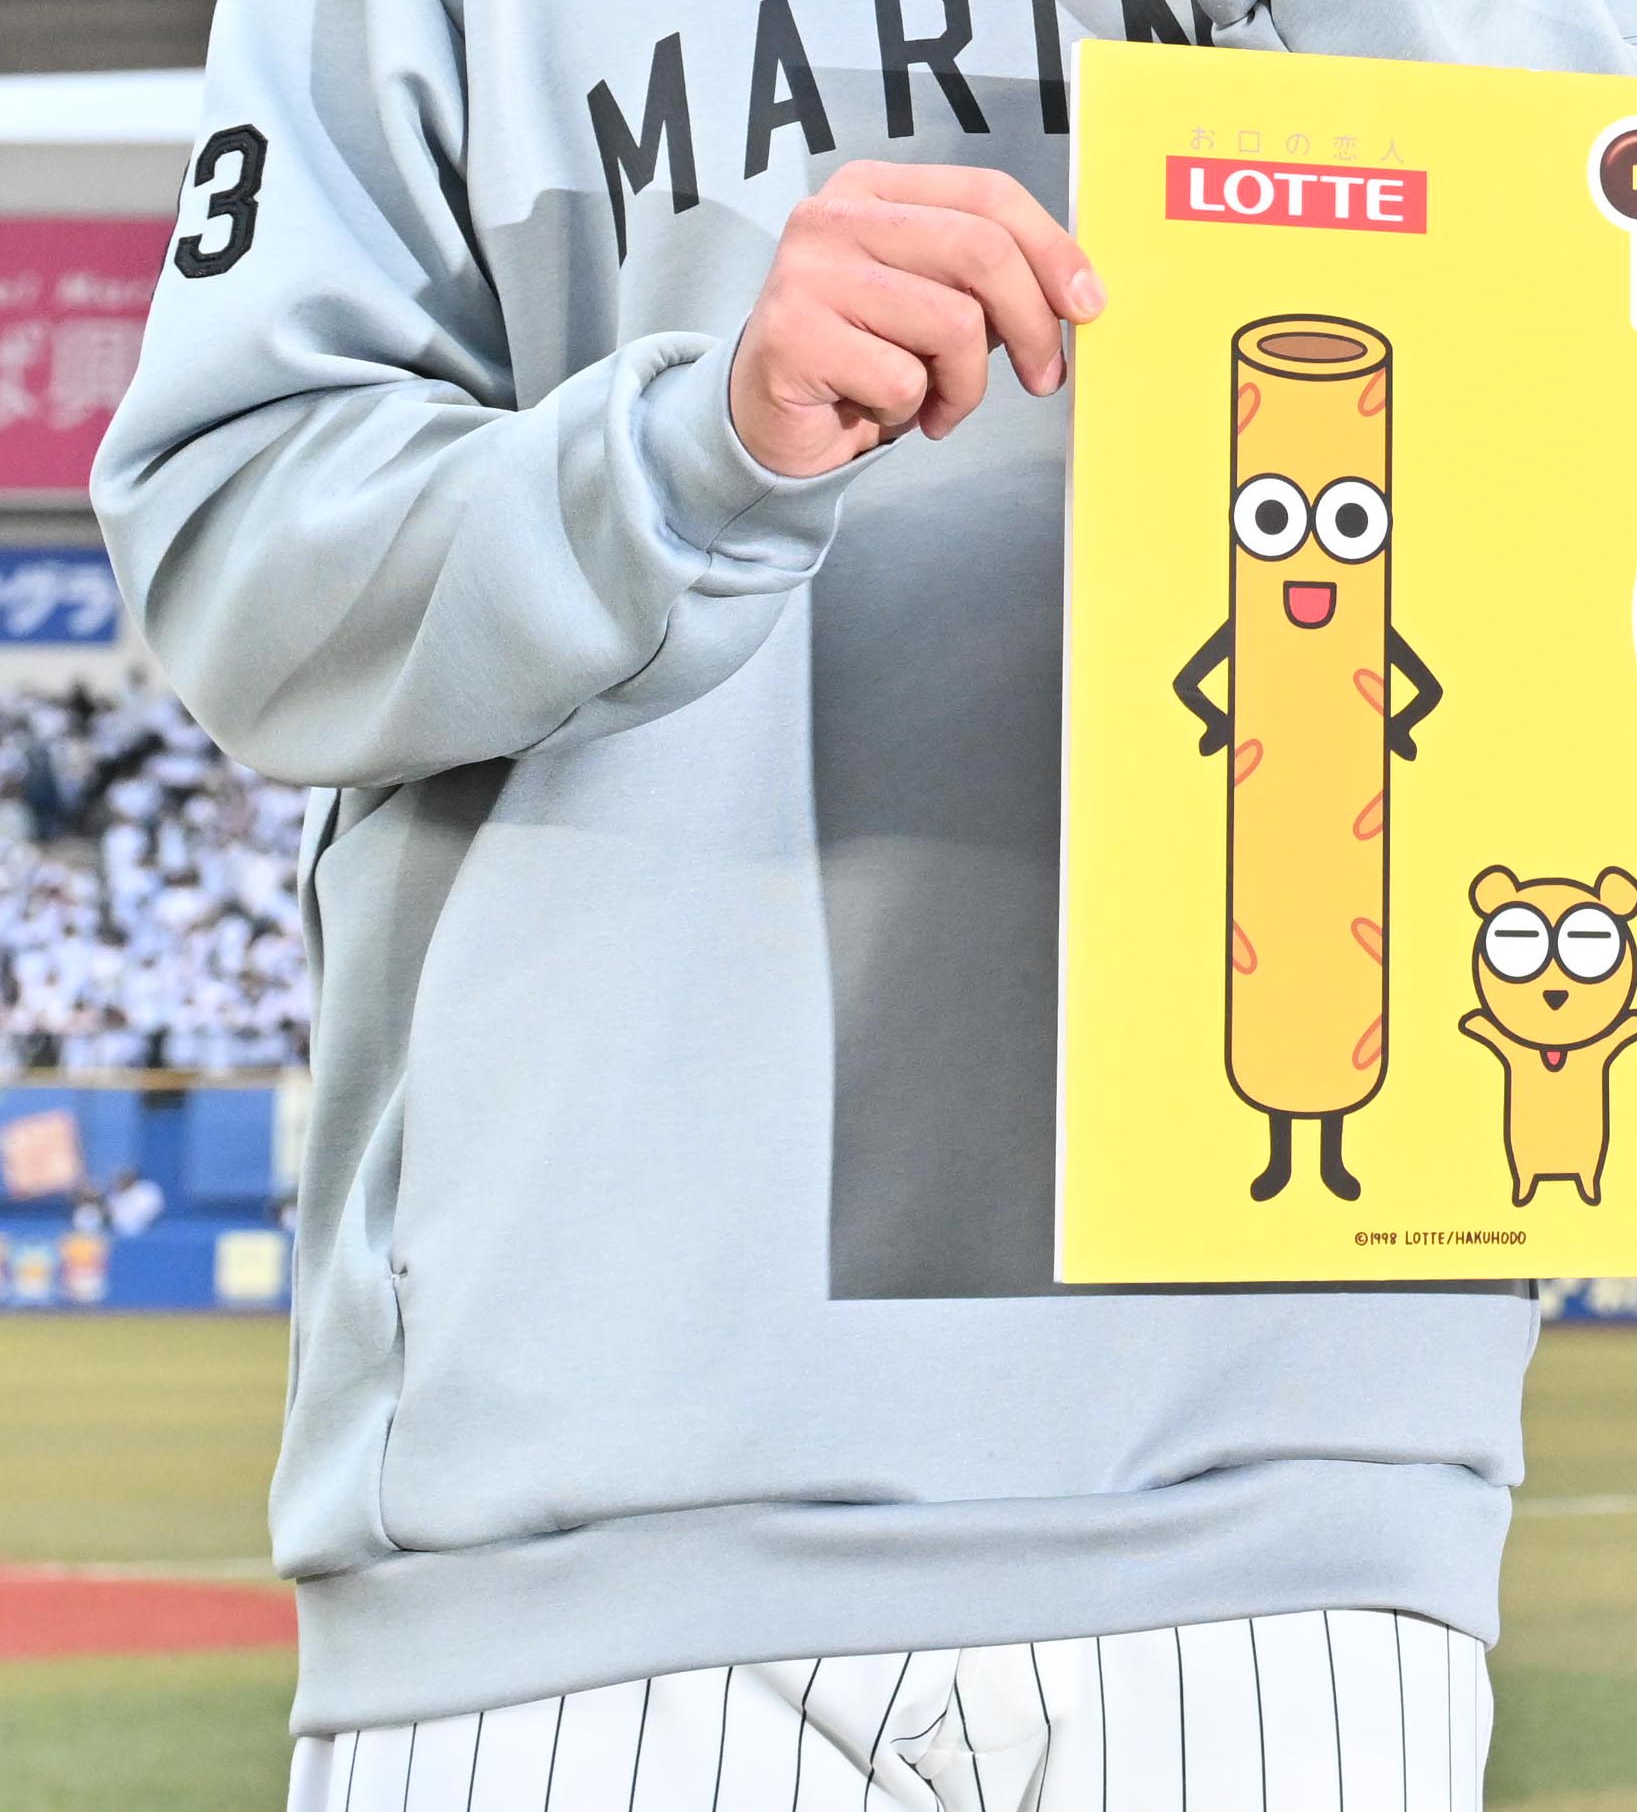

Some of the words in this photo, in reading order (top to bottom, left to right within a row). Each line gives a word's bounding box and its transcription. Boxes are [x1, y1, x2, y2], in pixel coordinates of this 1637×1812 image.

[1189, 125, 1405, 165] お口の恋人
[1189, 166, 1405, 222] LOTTE
[1405, 1230, 1527, 1246] LOTTE/HAKUHODO
